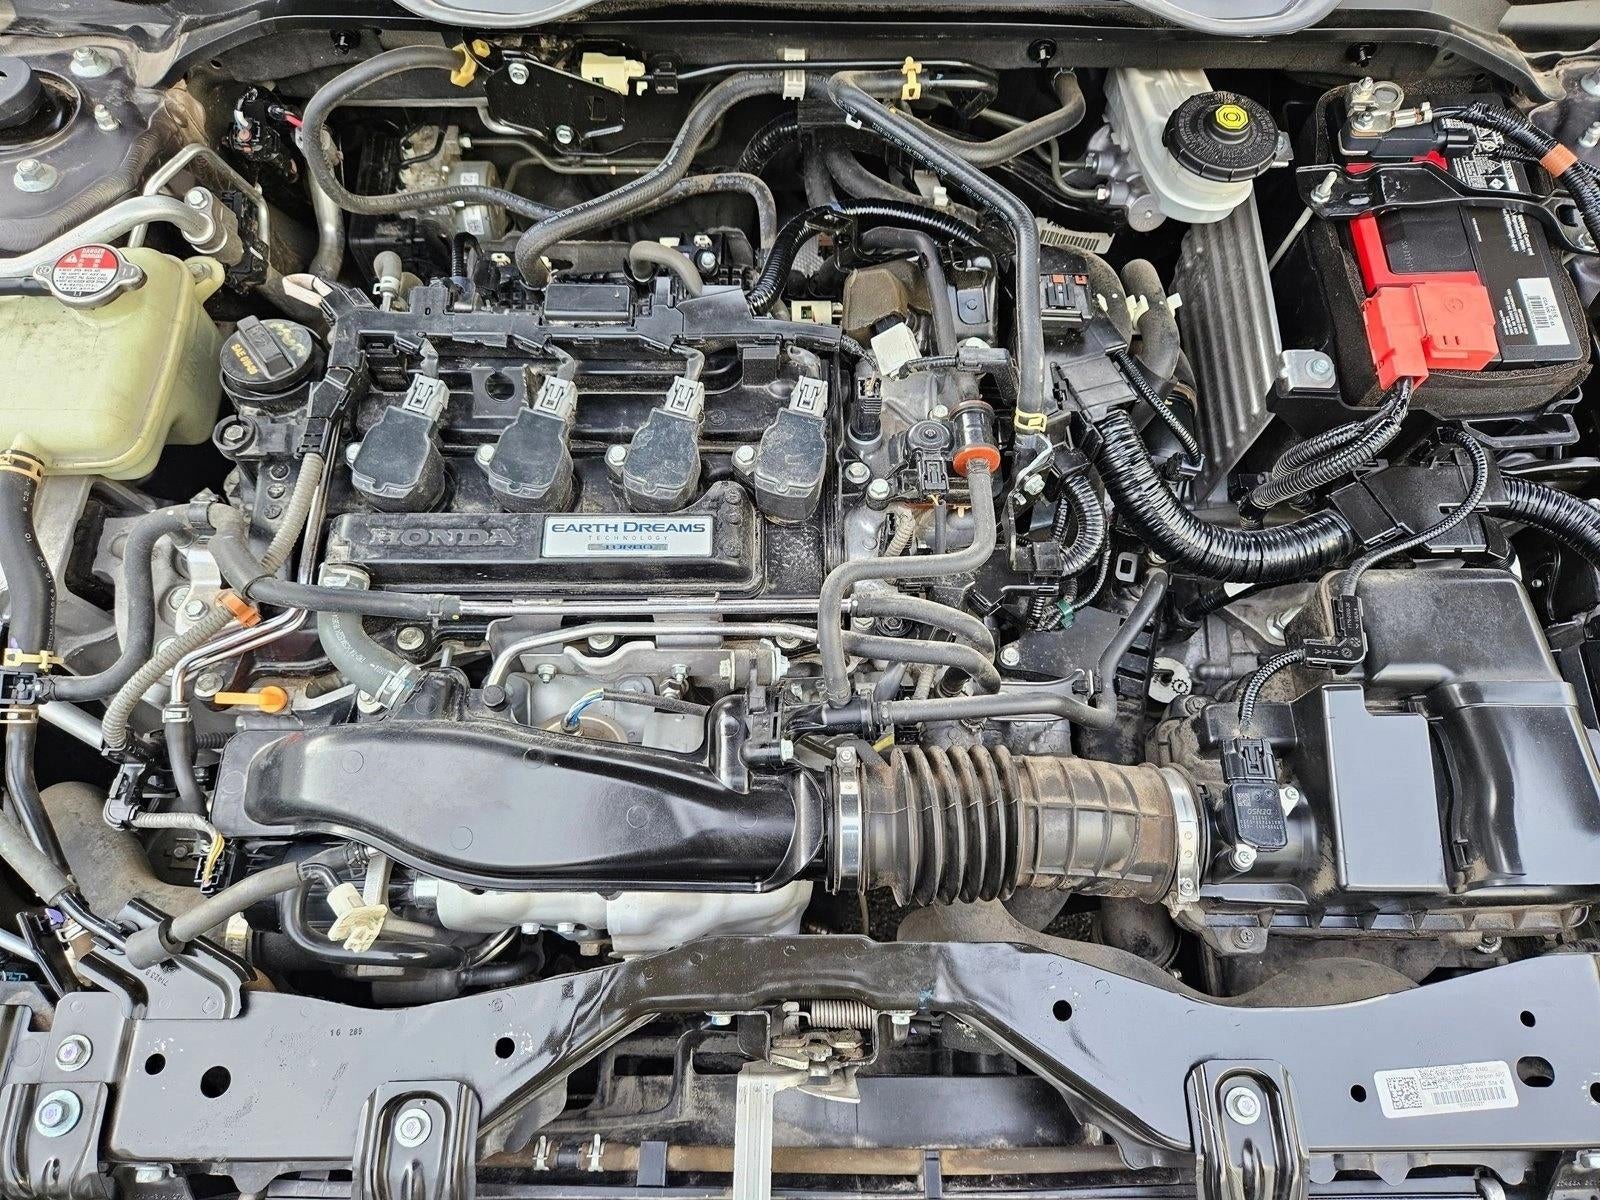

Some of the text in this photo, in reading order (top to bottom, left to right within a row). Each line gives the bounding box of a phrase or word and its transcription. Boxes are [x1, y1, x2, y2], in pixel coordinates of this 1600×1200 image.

[231, 343, 247, 358] SAE
[552, 522, 706, 533] EARTH DREAMS
[369, 527, 516, 547] HONDA
